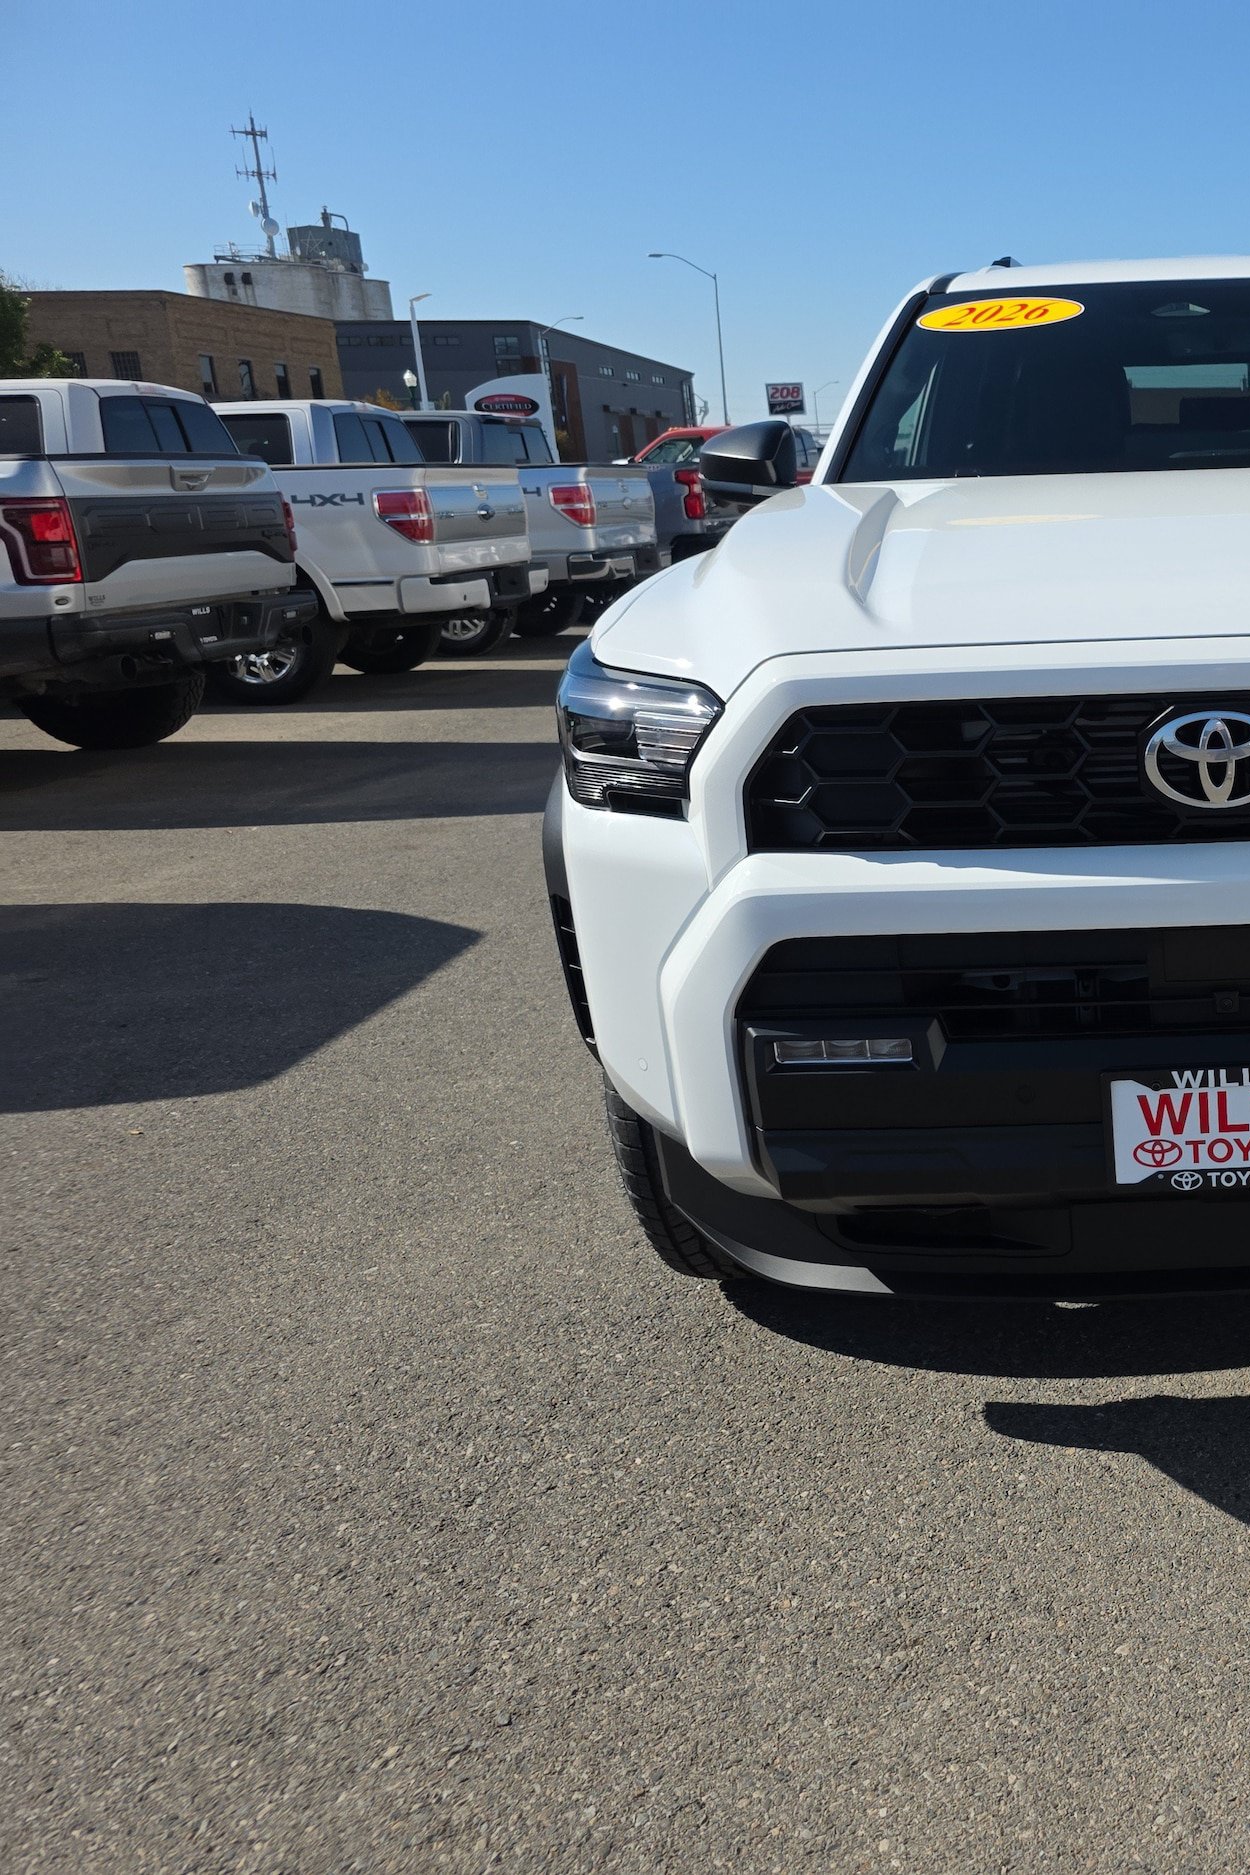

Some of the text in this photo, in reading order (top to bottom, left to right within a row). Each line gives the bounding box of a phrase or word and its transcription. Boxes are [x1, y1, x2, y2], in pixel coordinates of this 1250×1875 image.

[942, 302, 1059, 327] 2026
[771, 386, 800, 400] 208
[481, 402, 532, 411] CERTIFIED
[290, 492, 365, 507] 4X4
[88, 594, 106, 602] WILLS
[192, 606, 210, 616] WILLS
